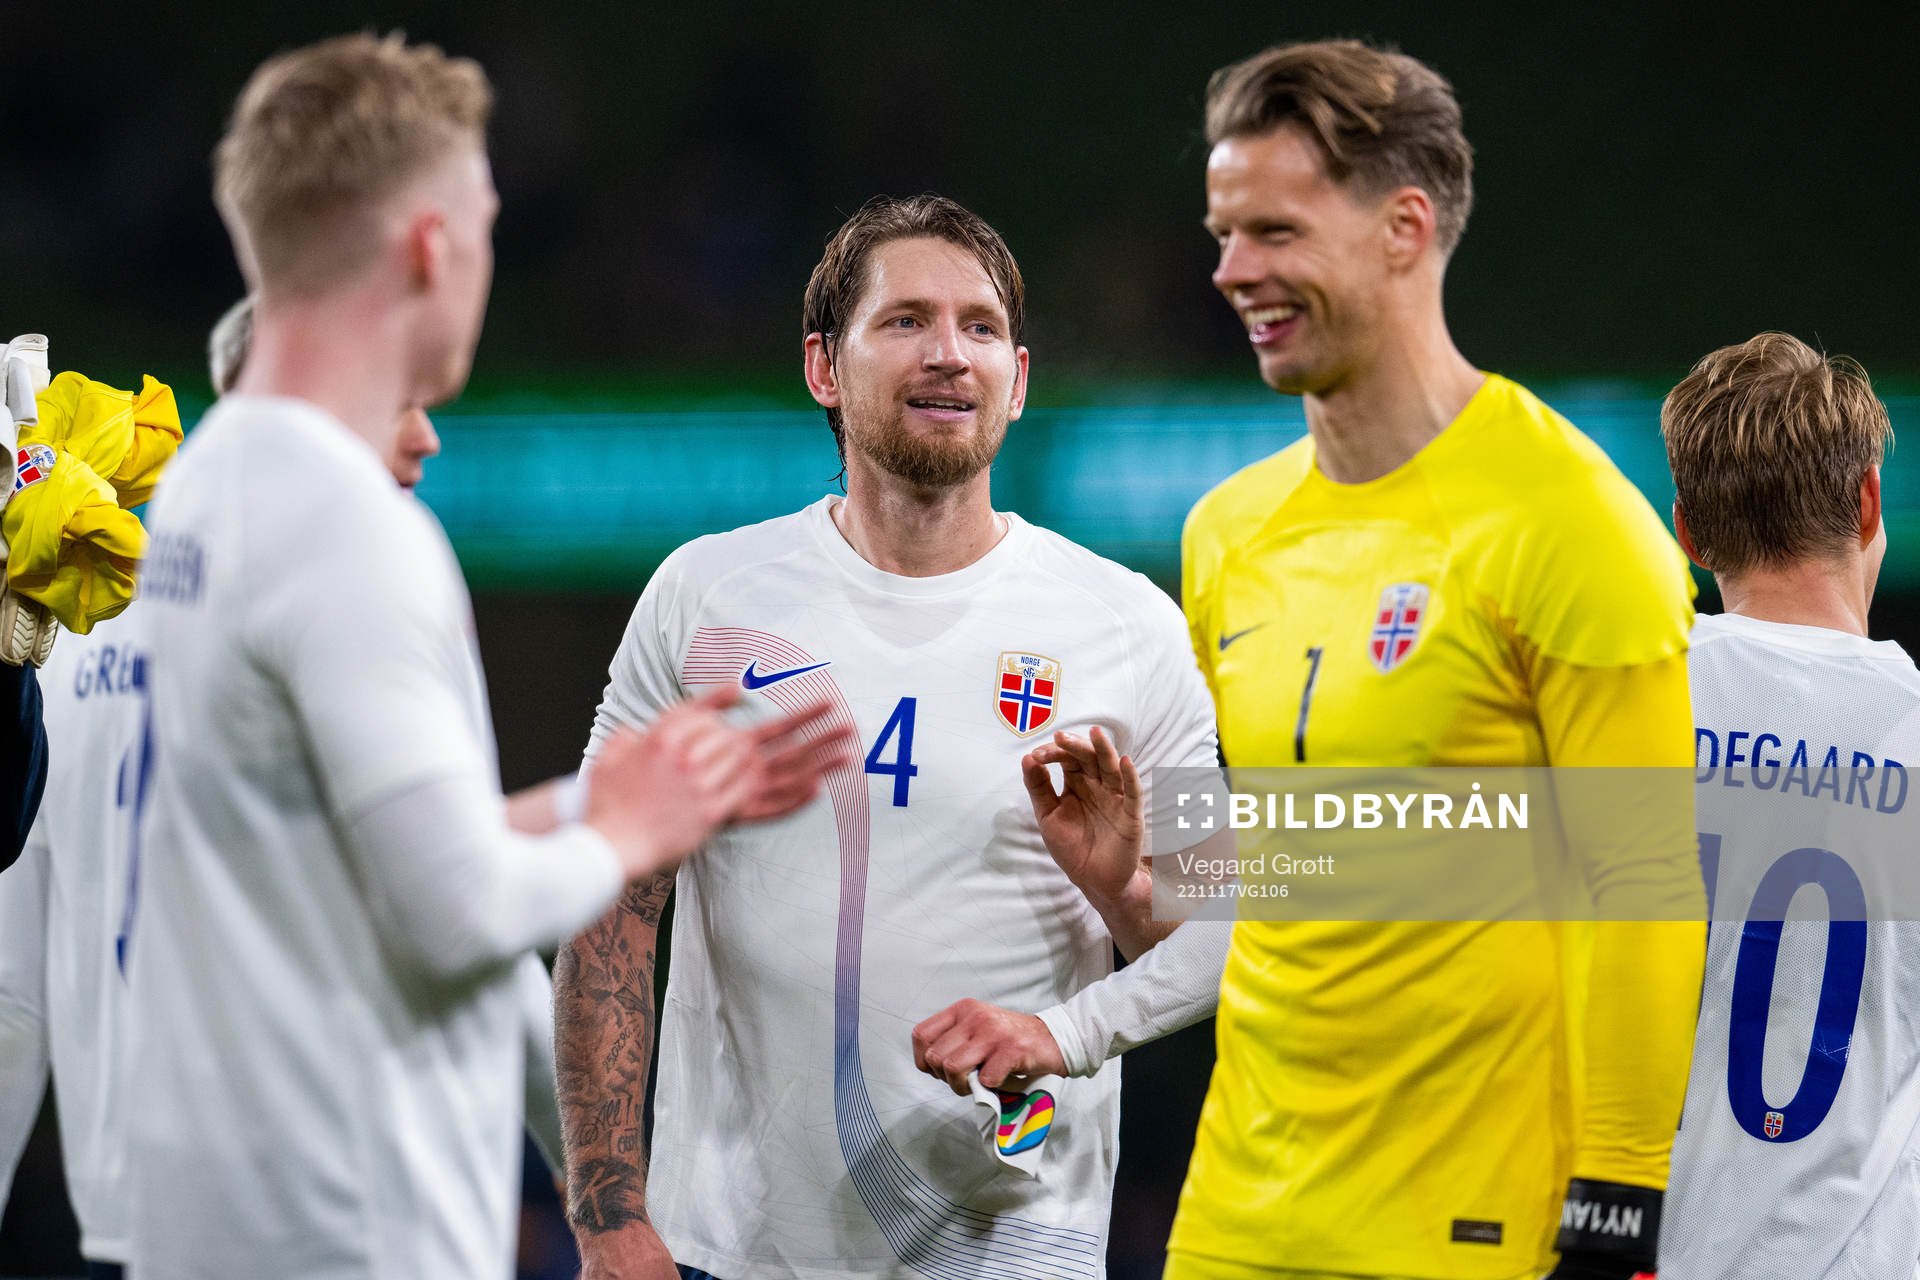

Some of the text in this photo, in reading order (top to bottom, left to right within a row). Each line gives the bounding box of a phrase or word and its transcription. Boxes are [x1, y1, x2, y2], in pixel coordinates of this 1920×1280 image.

[1020, 655, 1041, 667] NORGE
[1296, 647, 1322, 762] 1
[864, 696, 918, 807] 4
